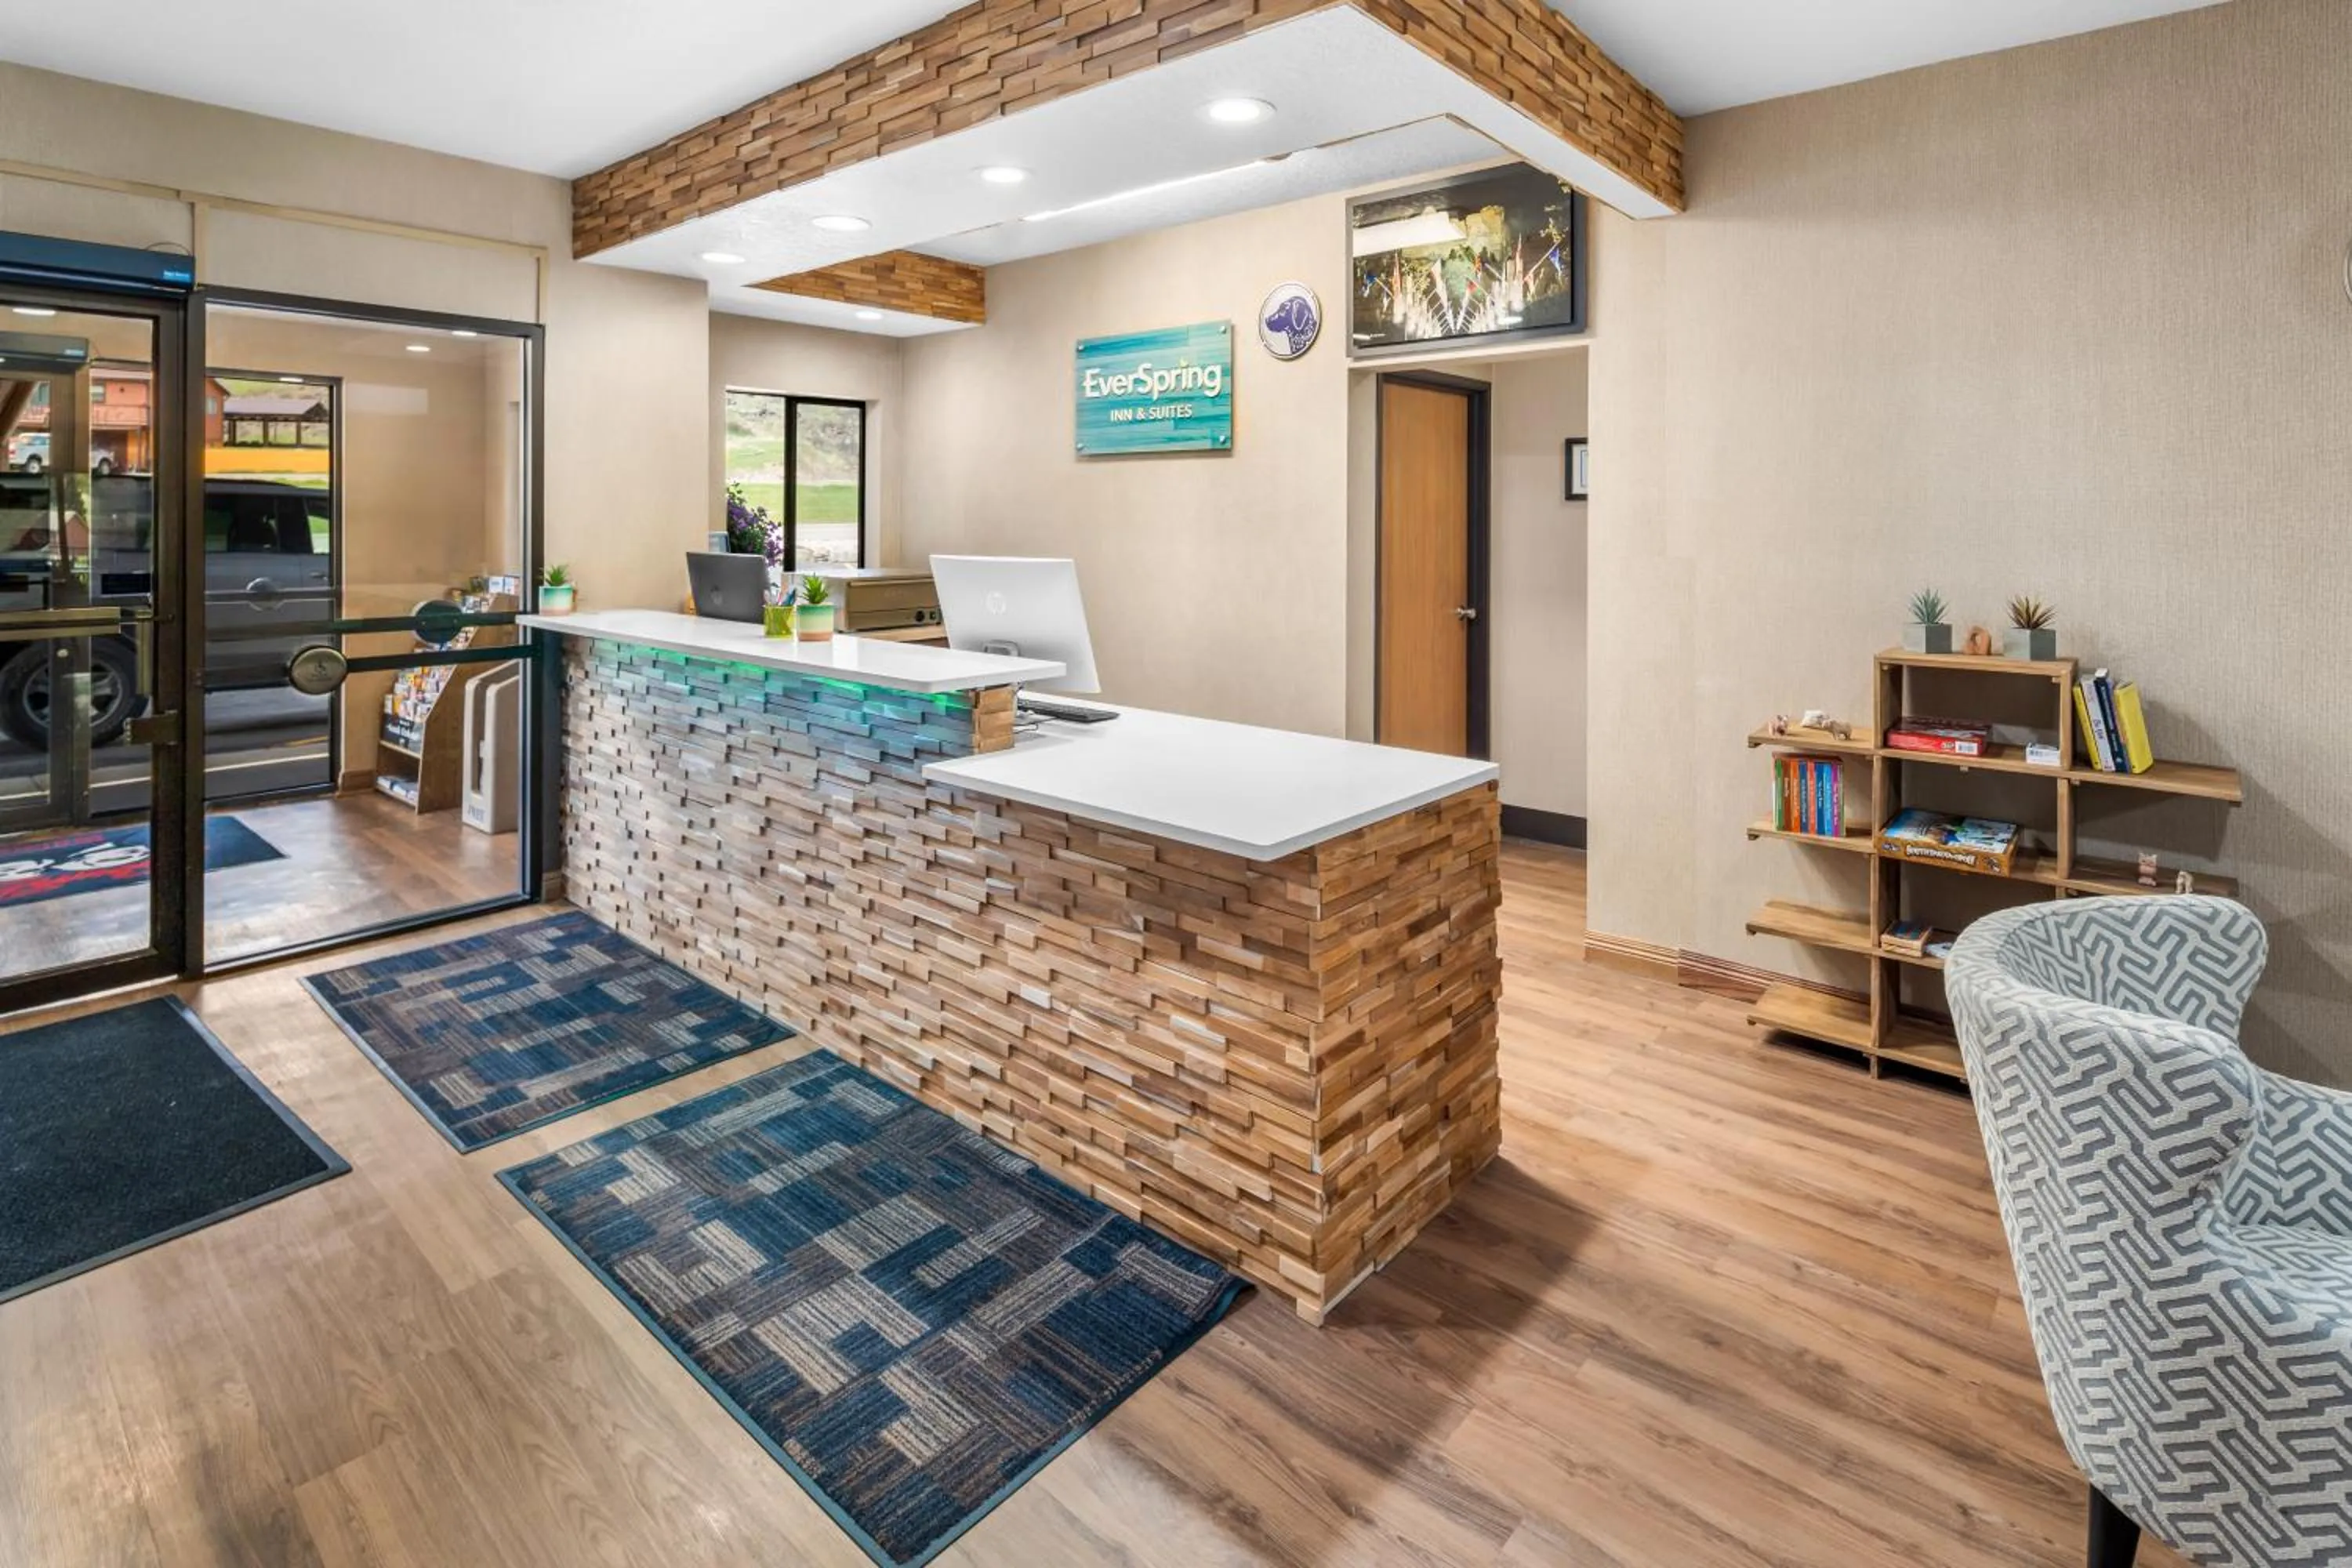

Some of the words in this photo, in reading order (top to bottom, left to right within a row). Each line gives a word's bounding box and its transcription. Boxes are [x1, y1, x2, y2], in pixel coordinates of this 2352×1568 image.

[1082, 358, 1222, 401] EverSpring
[1110, 408, 1133, 421] INN
[1137, 408, 1145, 420] &
[1149, 404, 1192, 419] SUITES
